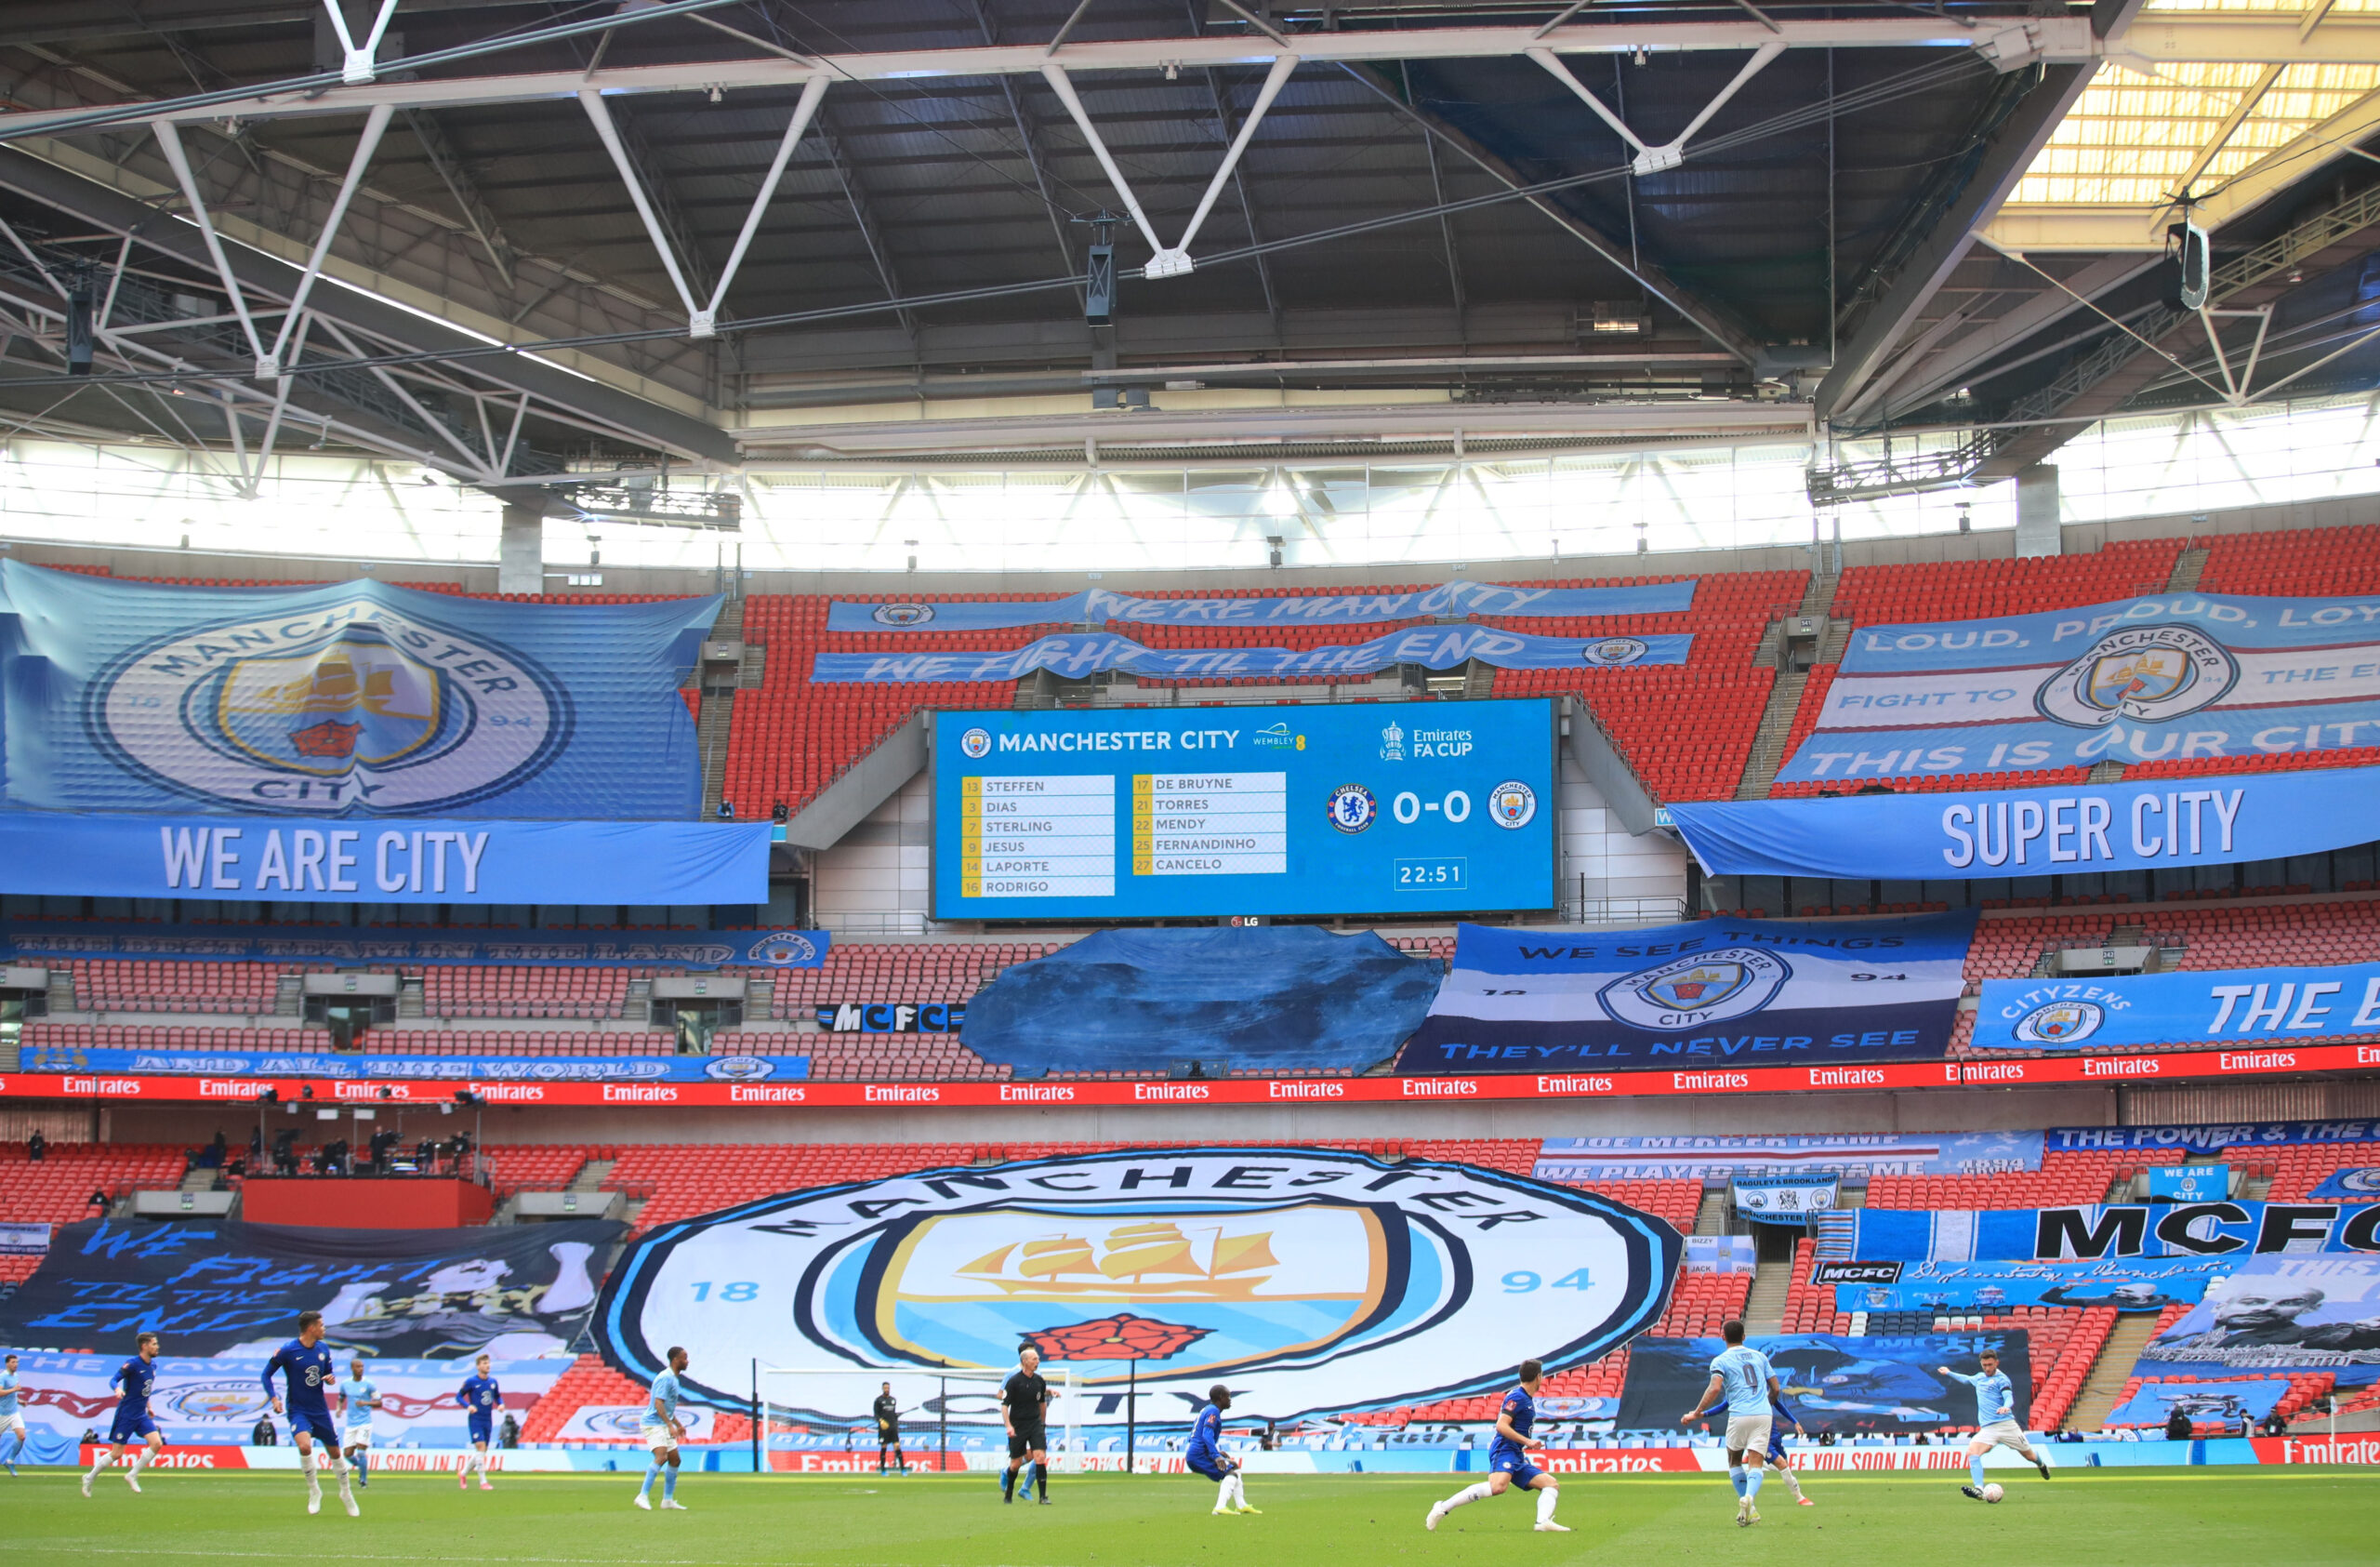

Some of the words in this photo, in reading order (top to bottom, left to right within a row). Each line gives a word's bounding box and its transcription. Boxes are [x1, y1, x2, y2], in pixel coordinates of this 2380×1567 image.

[1085, 588, 1254, 619] WE'RE
[1269, 593, 1405, 618] MAN
[1419, 581, 1553, 612] CITY
[1864, 630, 2030, 653] LOUD,
[2053, 601, 2256, 637] PROUD,
[2278, 605, 2380, 626] LOY
[152, 600, 519, 697] MANCHESTER
[864, 657, 953, 679] WE
[1275, 644, 1384, 673] THE
[1395, 631, 1525, 658] END
[2070, 627, 2218, 677] MANCHESTER
[2261, 667, 2339, 684] THE
[1839, 693, 1955, 710] FIGHT
[1964, 690, 2017, 704] TO
[491, 714, 533, 728] 94
[998, 731, 1171, 751] MANCHESTER
[1181, 730, 1239, 750] CITY
[1253, 737, 1294, 746] WEMBLEY
[1414, 729, 1472, 742] Emirates
[1414, 743, 1435, 757] FA
[1437, 742, 1473, 757] CUP
[1811, 746, 1970, 777] THIS
[1988, 740, 2052, 767] IS
[2074, 723, 2244, 762] OUR
[2252, 721, 2380, 752] CIT
[252, 779, 386, 800] CITY
[967, 782, 978, 792] 13
[986, 781, 1044, 791] STEFFEN
[1137, 780, 1148, 790] 17
[1156, 779, 1173, 790] DE
[1178, 778, 1233, 790] BRUYNE
[1335, 786, 1368, 797] CHELSEA
[1493, 783, 1533, 800] MANCHESTER
[969, 803, 976, 813] 3
[986, 802, 1017, 812] DIAS
[1137, 801, 1148, 810] 21
[1156, 800, 1209, 810] TORRES
[969, 822, 976, 832] 7
[985, 821, 1052, 832] STERLING
[1136, 820, 1149, 830] 22
[1156, 819, 1206, 830] MENDY
[1943, 797, 2112, 869] SUPER
[2131, 789, 2245, 858] CITY
[969, 843, 976, 853] 9
[985, 843, 1025, 853] JESUS
[1136, 841, 1150, 850] 25
[1156, 839, 1256, 850] FERNANDINHO
[161, 827, 241, 890] WE
[256, 827, 360, 892] ARE
[376, 830, 490, 894] CITY
[967, 862, 978, 871] 14
[986, 861, 1050, 871] LAPORTE
[1136, 861, 1150, 870] 27
[1156, 859, 1222, 870] CANCELO
[1400, 866, 1459, 883] 22:51
[966, 883, 979, 892] 16
[986, 882, 1049, 893] RODRIGO
[1244, 918, 1258, 927] LG
[119, 936, 253, 955] BEST
[258, 938, 411, 959] TEAM
[416, 942, 477, 959] IN
[483, 943, 588, 961] THE
[593, 943, 735, 964] LAND
[1519, 945, 1597, 960] WE
[1616, 936, 1705, 957] SEE
[1723, 931, 1905, 950] THINGS
[1625, 949, 1773, 987] MANCHESTER
[1850, 973, 1911, 981] 94
[2001, 985, 2131, 1018] CITYZENS
[2207, 981, 2342, 1033] THE
[833, 1004, 945, 1031] MCFC
[1659, 1011, 1714, 1026] CITY
[1439, 1043, 1631, 1059] THEY'LL
[1649, 1035, 1812, 1056] NEVER
[1829, 1030, 1919, 1048] SEE
[129, 1056, 250, 1072] AND
[478, 1062, 669, 1080] WORLD
[2084, 1058, 2159, 1076] Emirates
[2220, 1052, 2295, 1070] Emirates
[1809, 1069, 1884, 1085] Emirates
[1946, 1063, 2023, 1081] Emirates
[62, 1077, 140, 1095] Emirates
[1269, 1081, 1343, 1098] Emirates
[1402, 1079, 1477, 1096] Emirates
[1538, 1075, 1612, 1093] Emirates
[1673, 1072, 1748, 1090] Emirates
[603, 1084, 678, 1101] Emirates
[731, 1084, 805, 1101] Emirates
[865, 1084, 939, 1102] Emirates
[999, 1084, 1074, 1102] Emirates
[1134, 1082, 1210, 1099] Emirates
[1571, 1137, 1630, 1148] JOE
[2057, 1128, 2126, 1147] THE
[2134, 1125, 2254, 1149] POWER
[2262, 1123, 2287, 1141] &
[2300, 1122, 2370, 1139] THE
[1536, 1166, 1592, 1179] WE
[1598, 1164, 1734, 1180] PLAYED
[1820, 1162, 1925, 1178] GAME
[2164, 1168, 2184, 1177] WE
[2188, 1167, 2215, 1176] ARE
[1737, 1179, 1775, 1188] BAGULEY
[747, 1166, 1548, 1238] MANCHESTER
[2173, 1191, 2204, 1201] CITY
[1823, 1267, 1895, 1279] MCFC
[2274, 1259, 2378, 1276] THIS
[690, 1281, 760, 1302] 18
[1501, 1267, 1595, 1294] 94
[305, 1364, 321, 1388] 3
[481, 1390, 494, 1406] 3
[921, 1389, 1253, 1414] CTY
[2282, 1438, 2380, 1465] Emirate
[387, 1454, 427, 1471] SOON
[433, 1454, 449, 1471] IN
[1813, 1453, 1845, 1470] YOU
[1851, 1452, 1897, 1470] SOON
[1908, 1452, 1922, 1470] IN
[1927, 1451, 1970, 1469] DUBA
